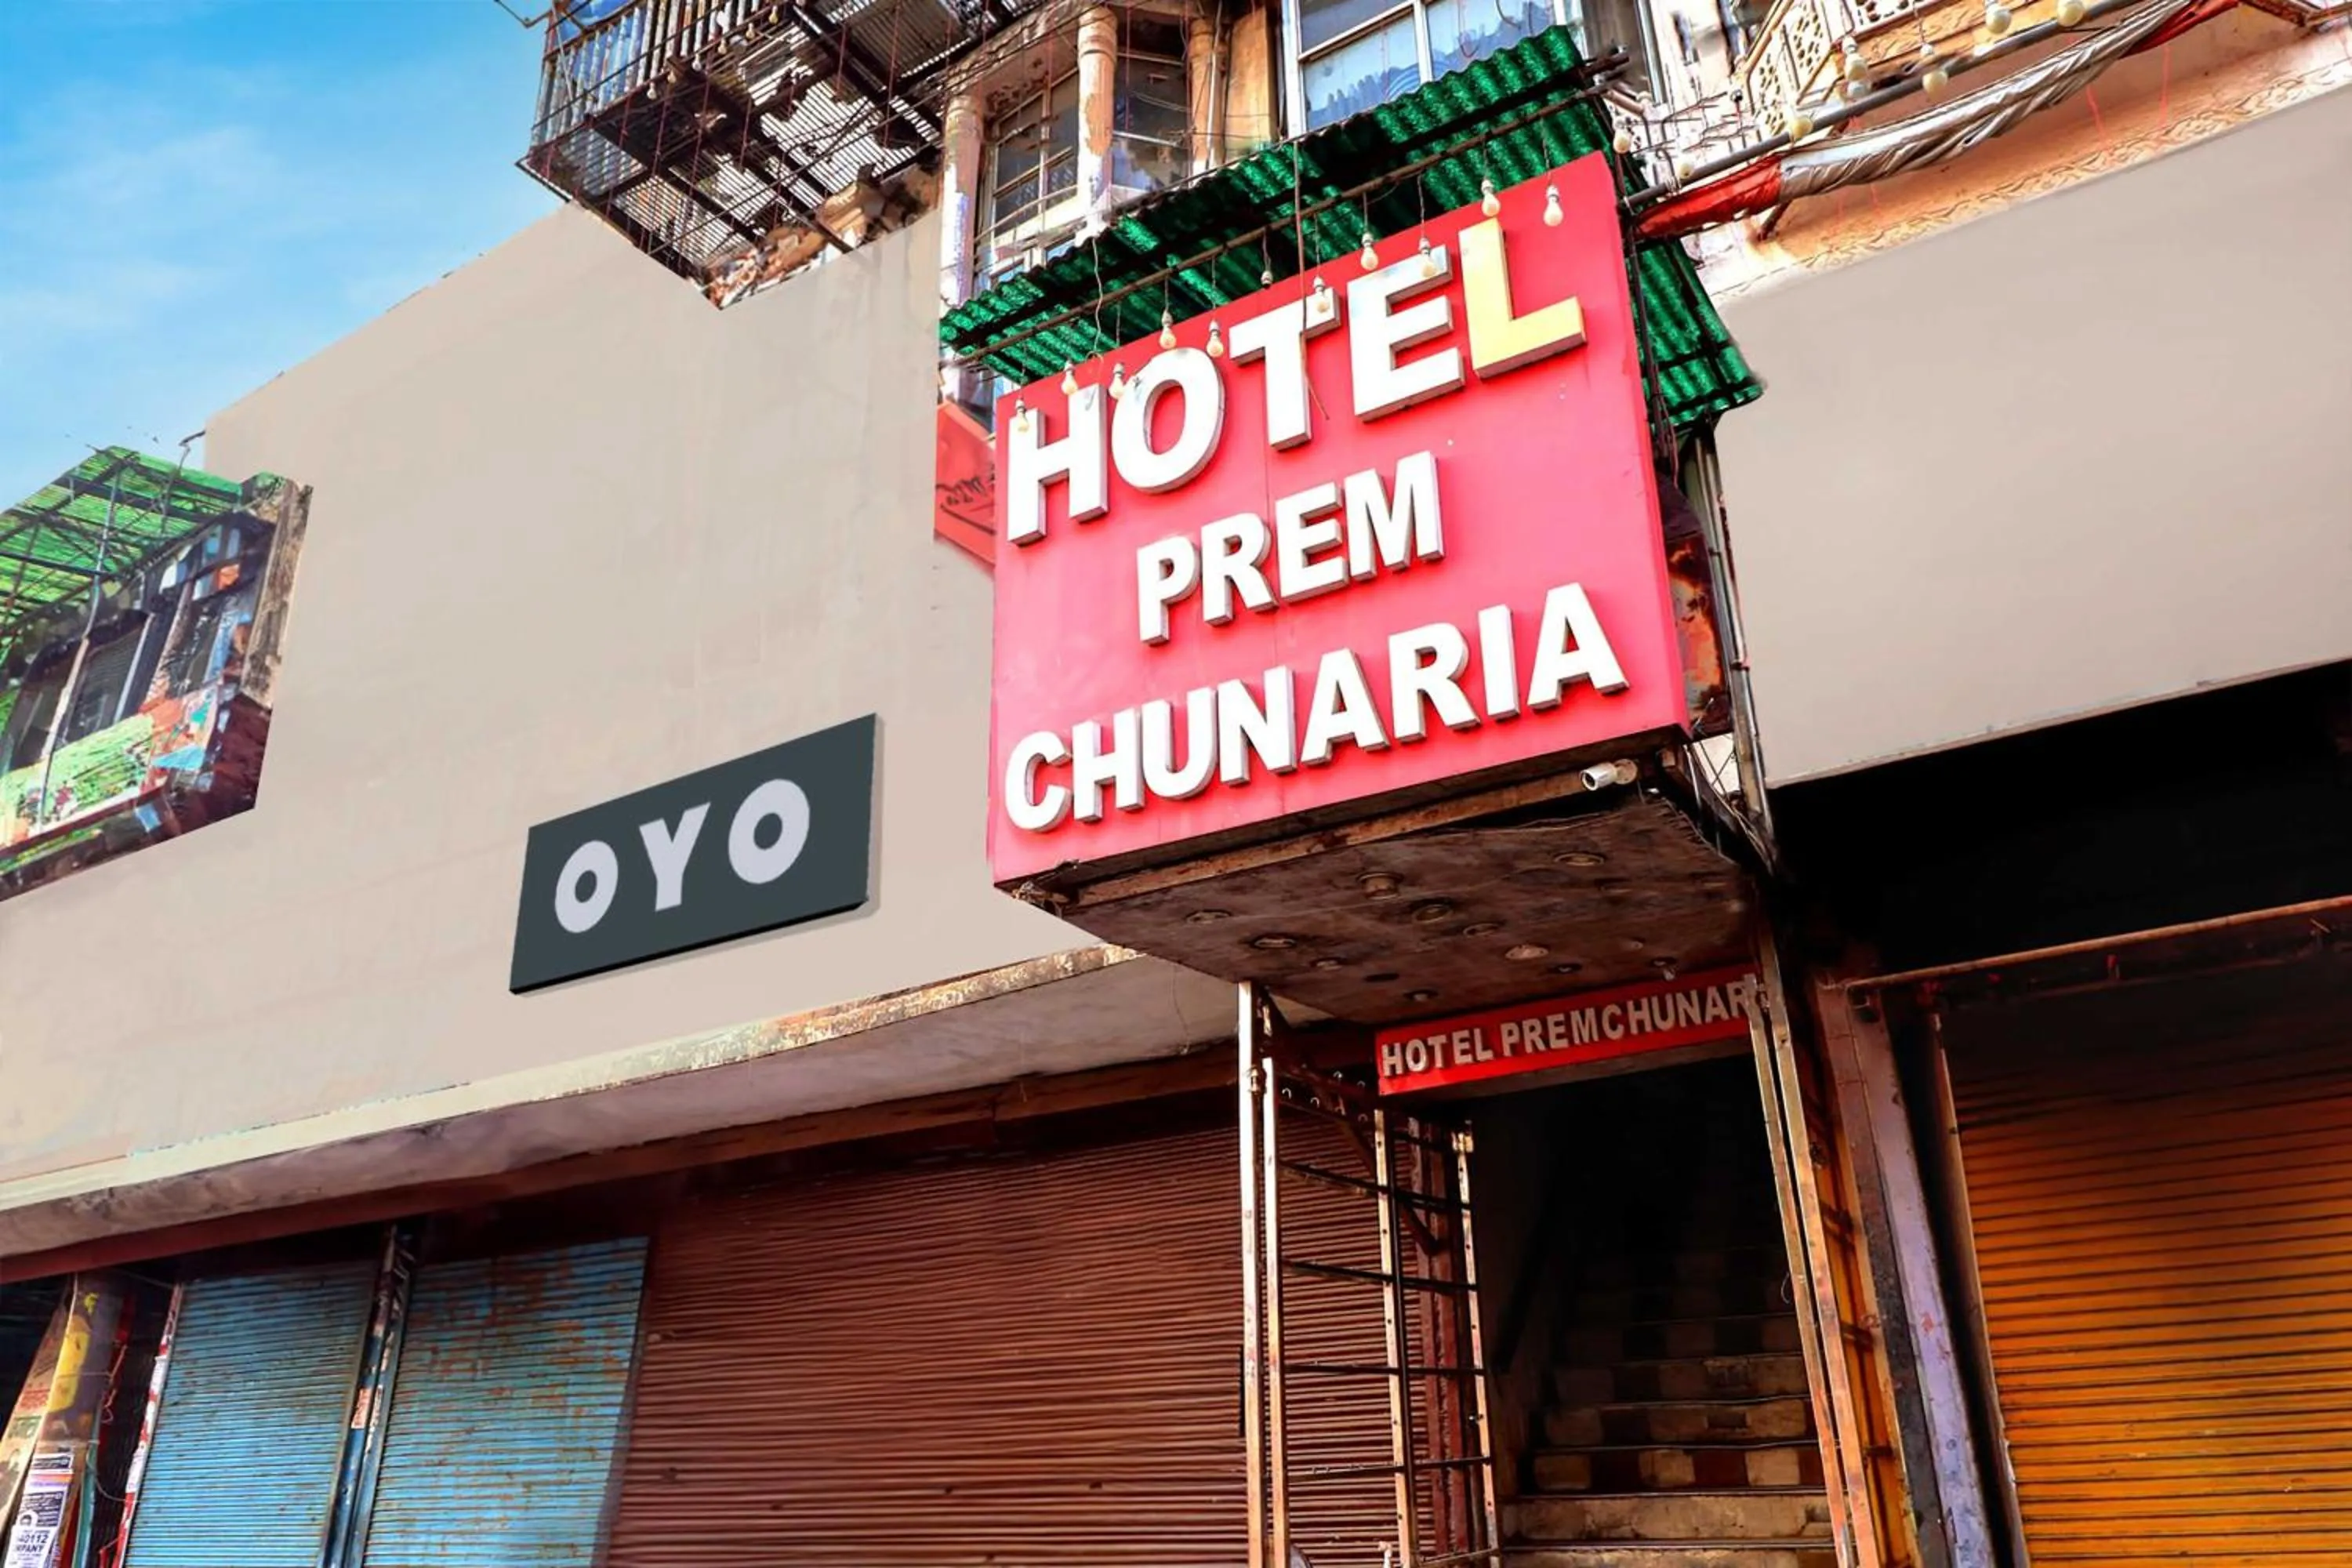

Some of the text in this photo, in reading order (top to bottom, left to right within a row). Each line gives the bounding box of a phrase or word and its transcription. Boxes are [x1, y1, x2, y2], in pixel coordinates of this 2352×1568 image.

[1007, 217, 1587, 546] HOTEL
[1137, 450, 1445, 646] PREM
[1004, 583, 1631, 833] CHUNARIA
[554, 779, 810, 934] OYO
[1381, 1027, 1494, 1076] HOTEL
